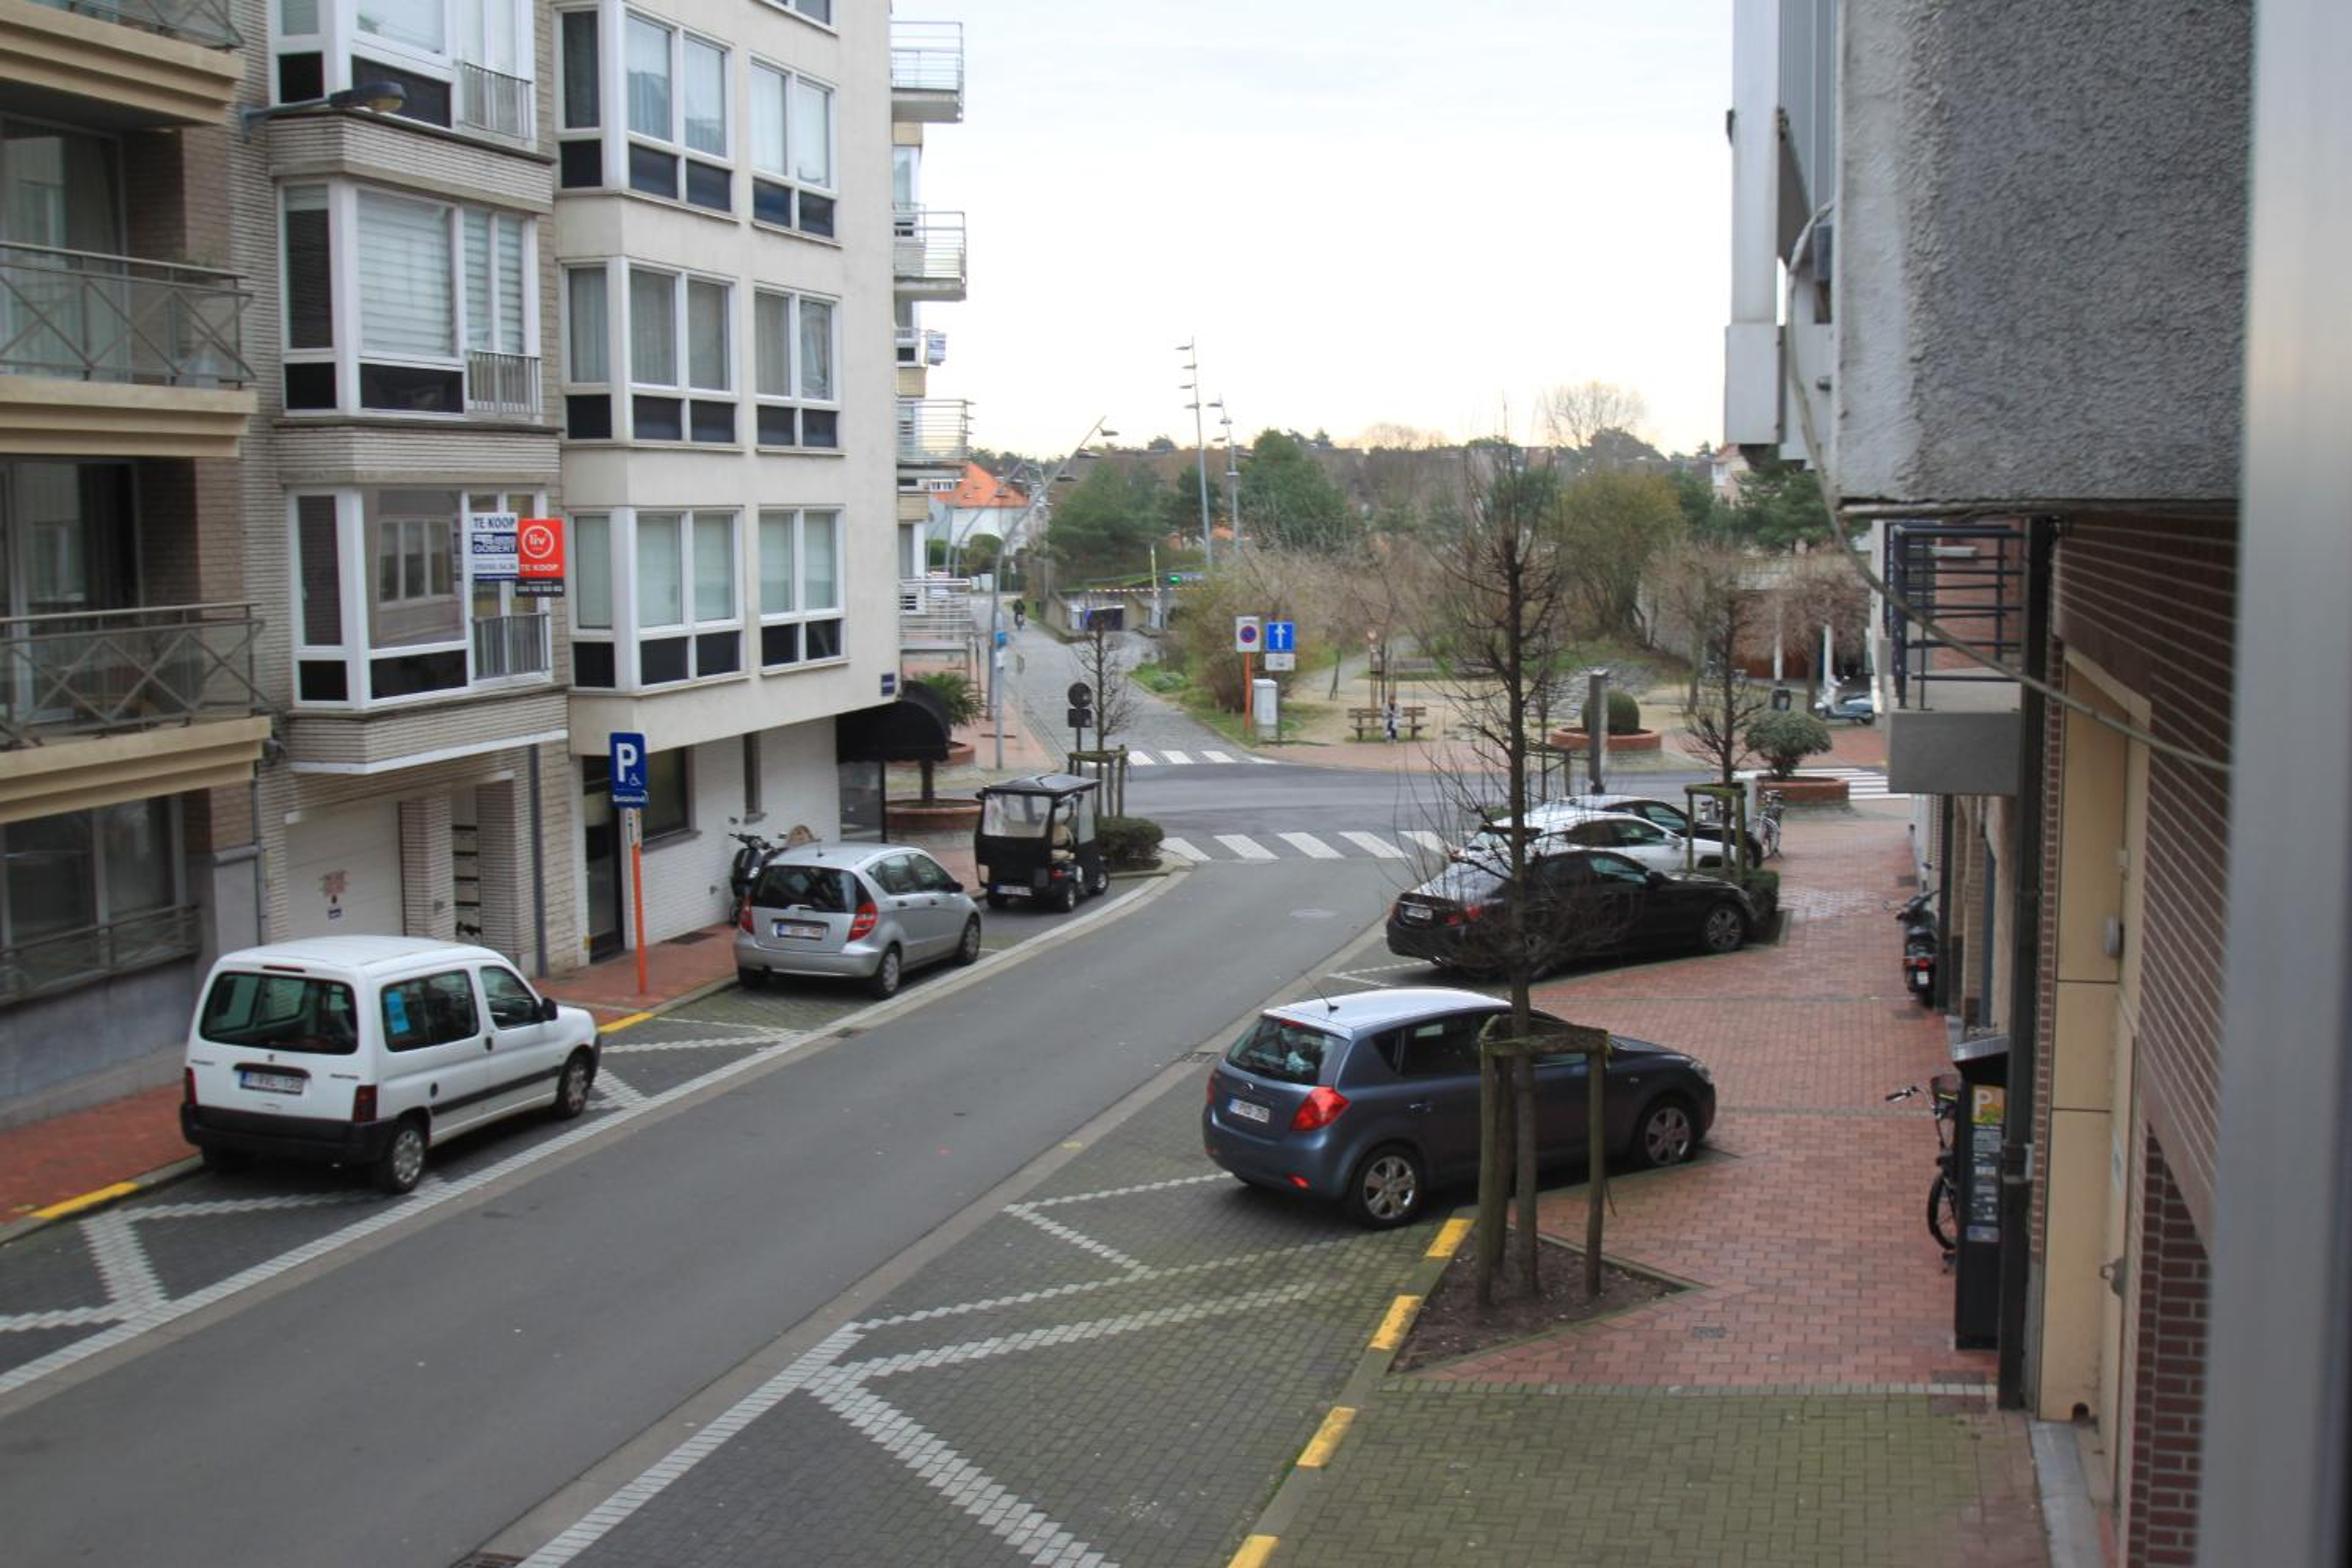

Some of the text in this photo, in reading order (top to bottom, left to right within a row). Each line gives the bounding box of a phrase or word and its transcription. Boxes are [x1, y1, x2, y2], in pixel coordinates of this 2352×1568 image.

[474, 517, 516, 529] TE KOOP
[534, 563, 559, 572] KOOP
[616, 742, 638, 782] P
[1975, 1087, 1993, 1117] P
